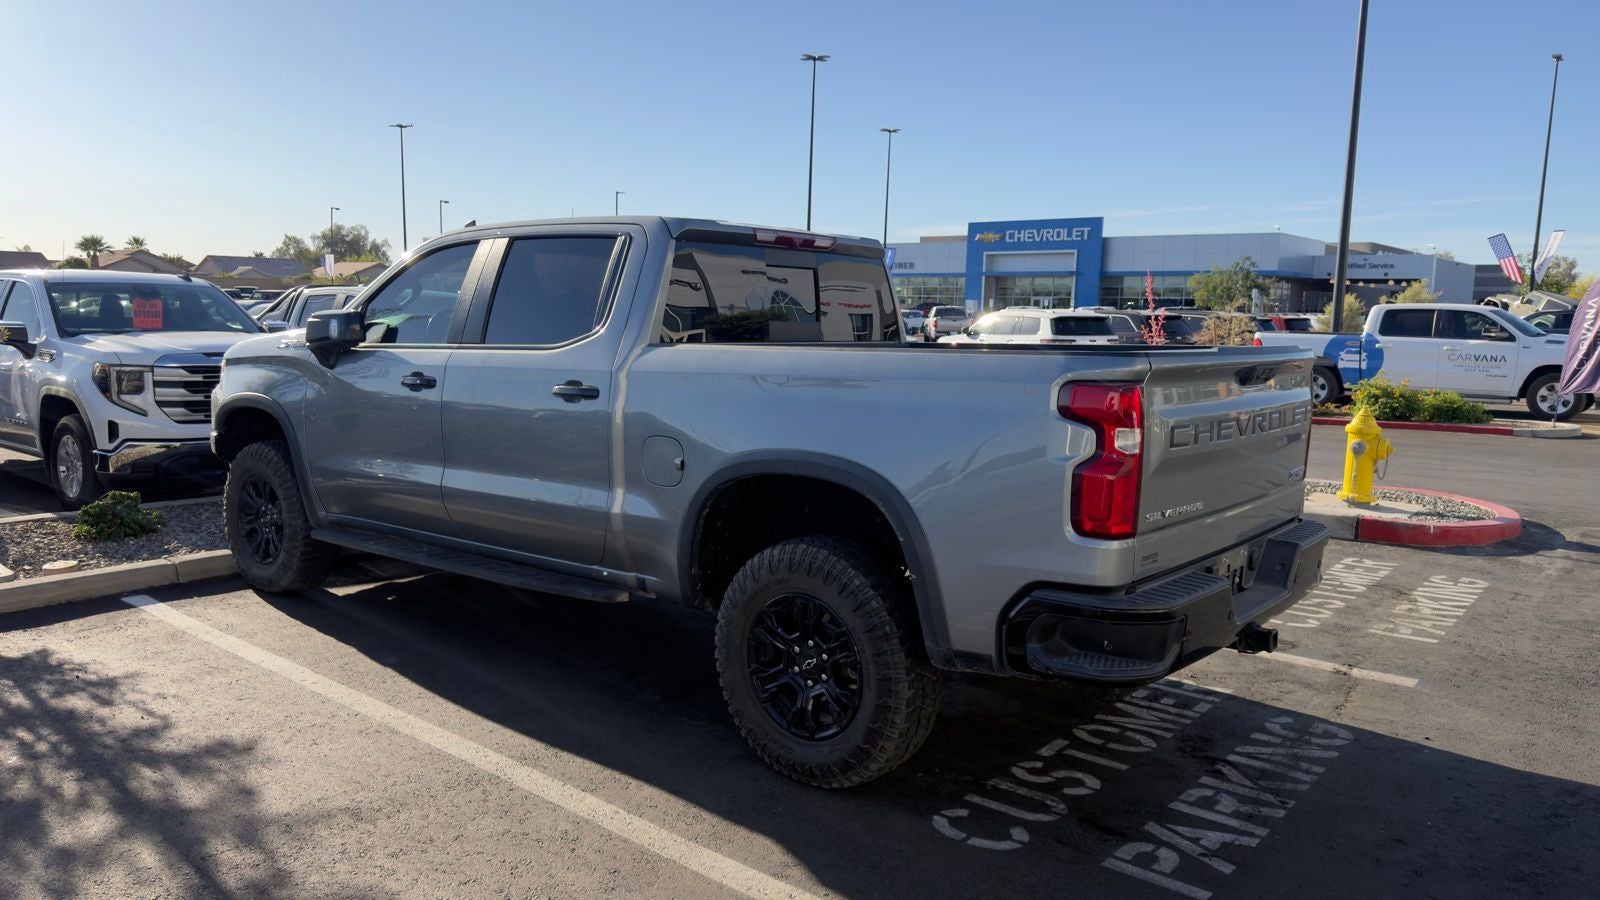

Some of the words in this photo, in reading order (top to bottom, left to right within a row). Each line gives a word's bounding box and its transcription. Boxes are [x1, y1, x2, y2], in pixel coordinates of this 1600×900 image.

[1005, 227, 1091, 242] CHEVROLET
[1368, 262, 1395, 270] Service
[133, 310, 161, 319] SPECIAL
[1447, 353, 1508, 363] CARVANA
[1169, 404, 1311, 450] CHEVROLET
[1145, 501, 1204, 522] SILVERADO
[1368, 574, 1491, 644] PARKING
[931, 677, 1234, 851] CUSTOMER
[1101, 716, 1355, 900] PARKING
